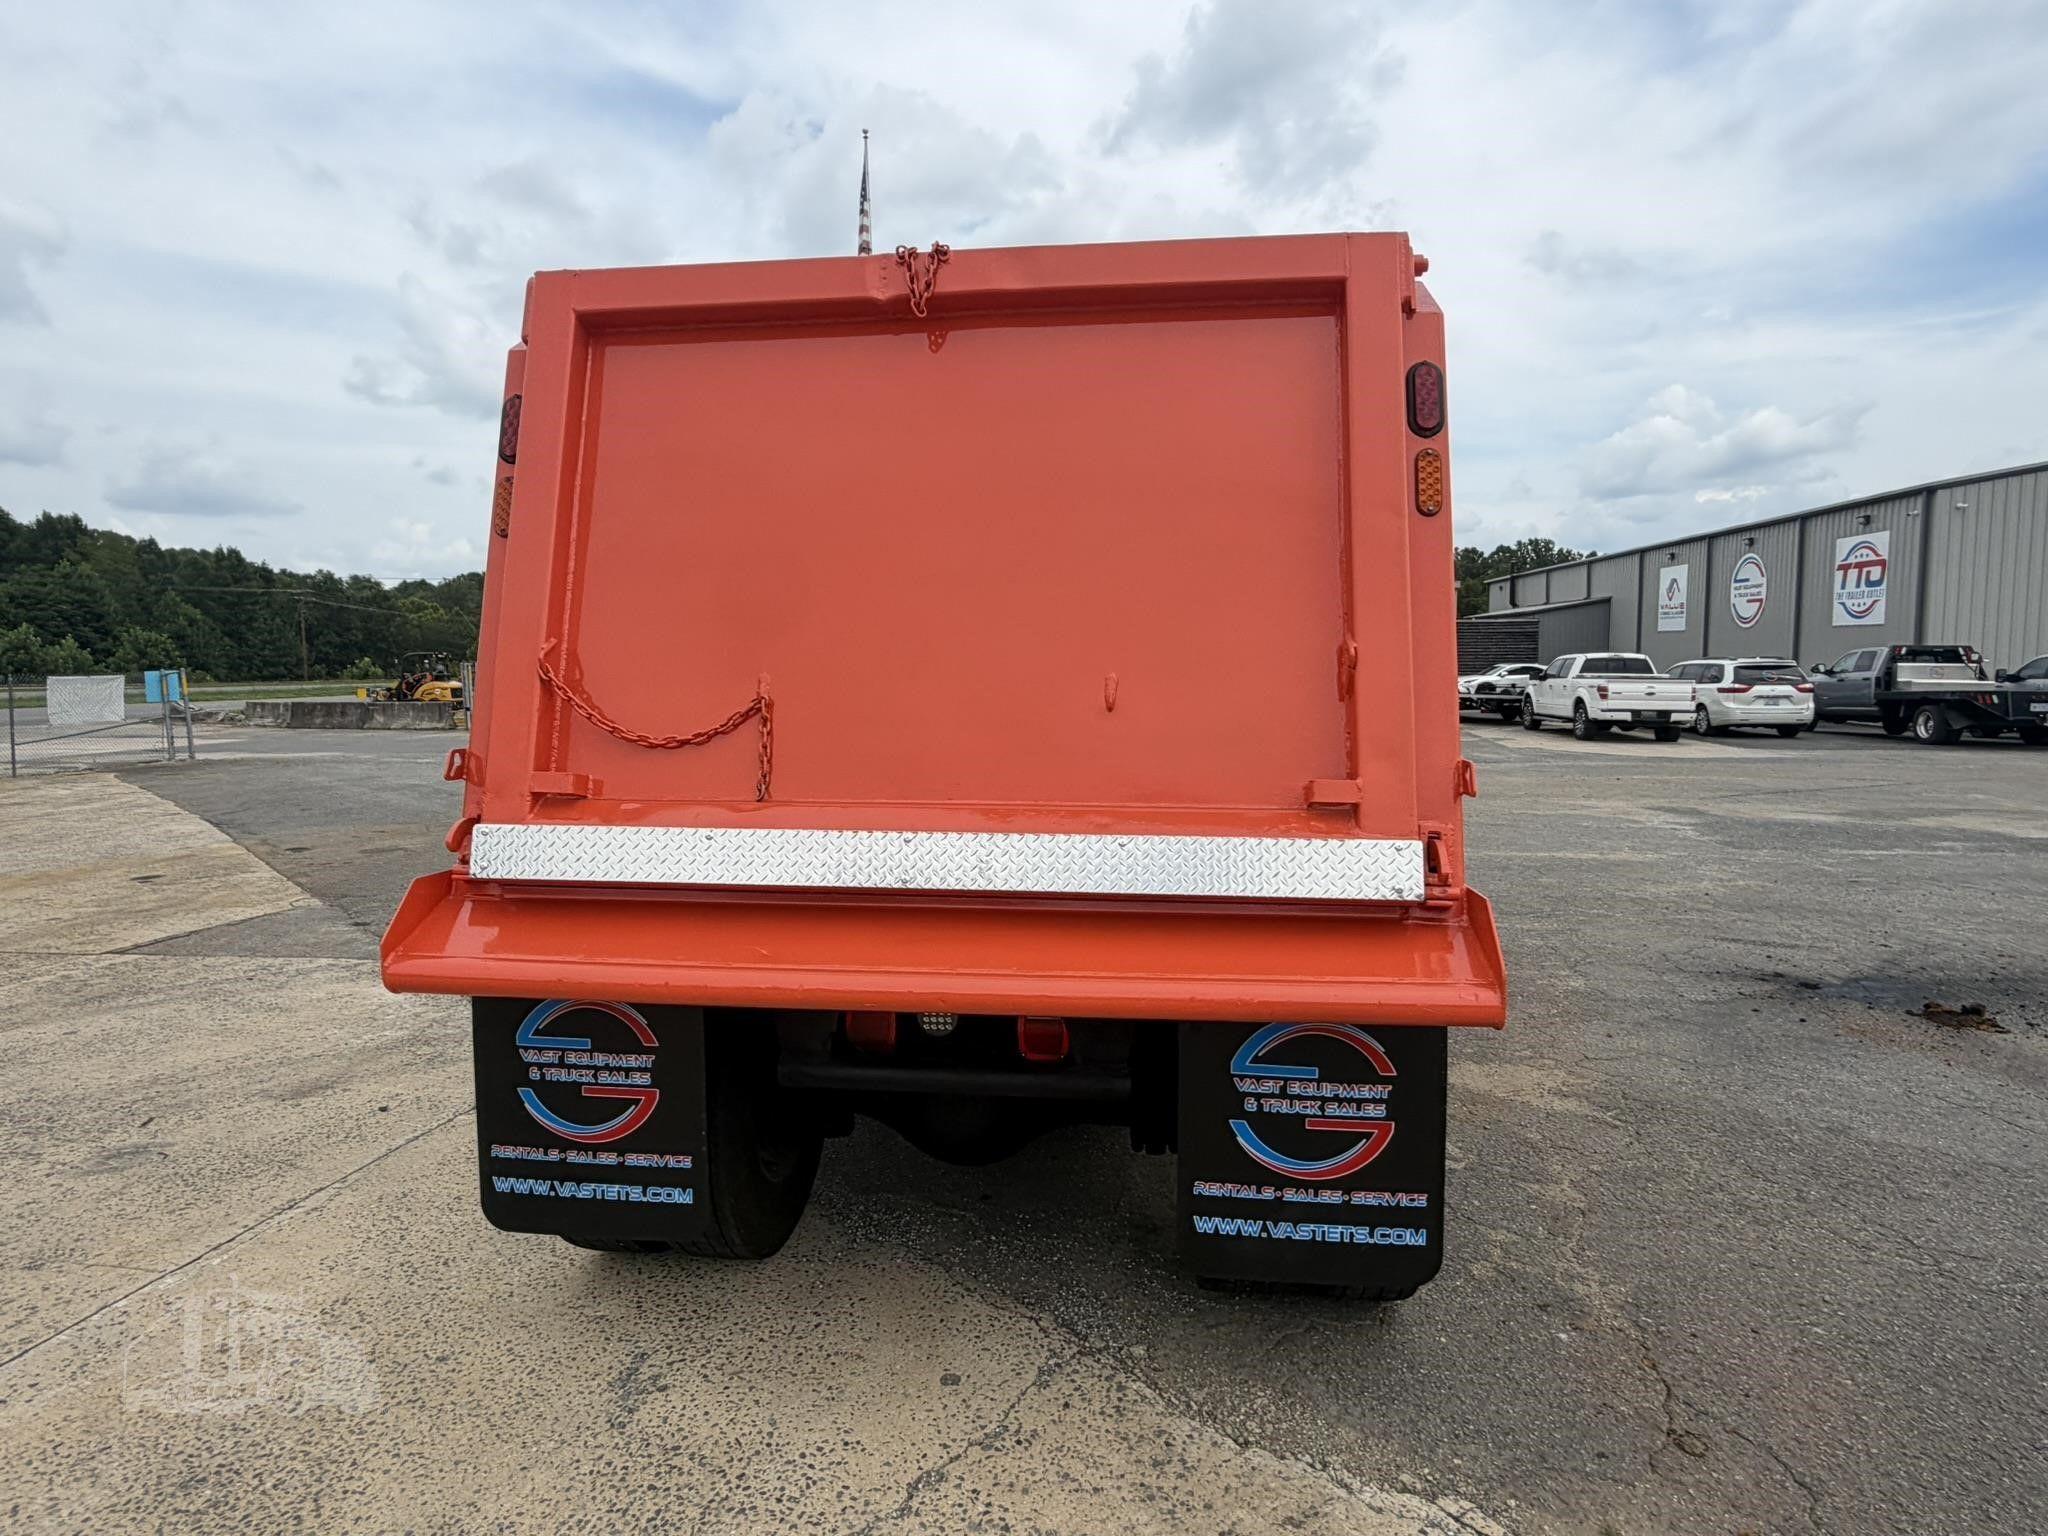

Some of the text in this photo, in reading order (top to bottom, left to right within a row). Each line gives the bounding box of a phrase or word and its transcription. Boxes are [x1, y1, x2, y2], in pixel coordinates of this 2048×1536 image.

[519, 1049, 655, 1068] VAST EQUIPMENT
[529, 1067, 651, 1085] & TRUCK SALES
[1233, 1077, 1392, 1099] VAST EQUIPMENT
[1244, 1098, 1386, 1117] & TRUCK SALES
[492, 1176, 693, 1204] WWW.VASTETS.COM
[1193, 1215, 1427, 1246] WWW.VASTETS.COM
